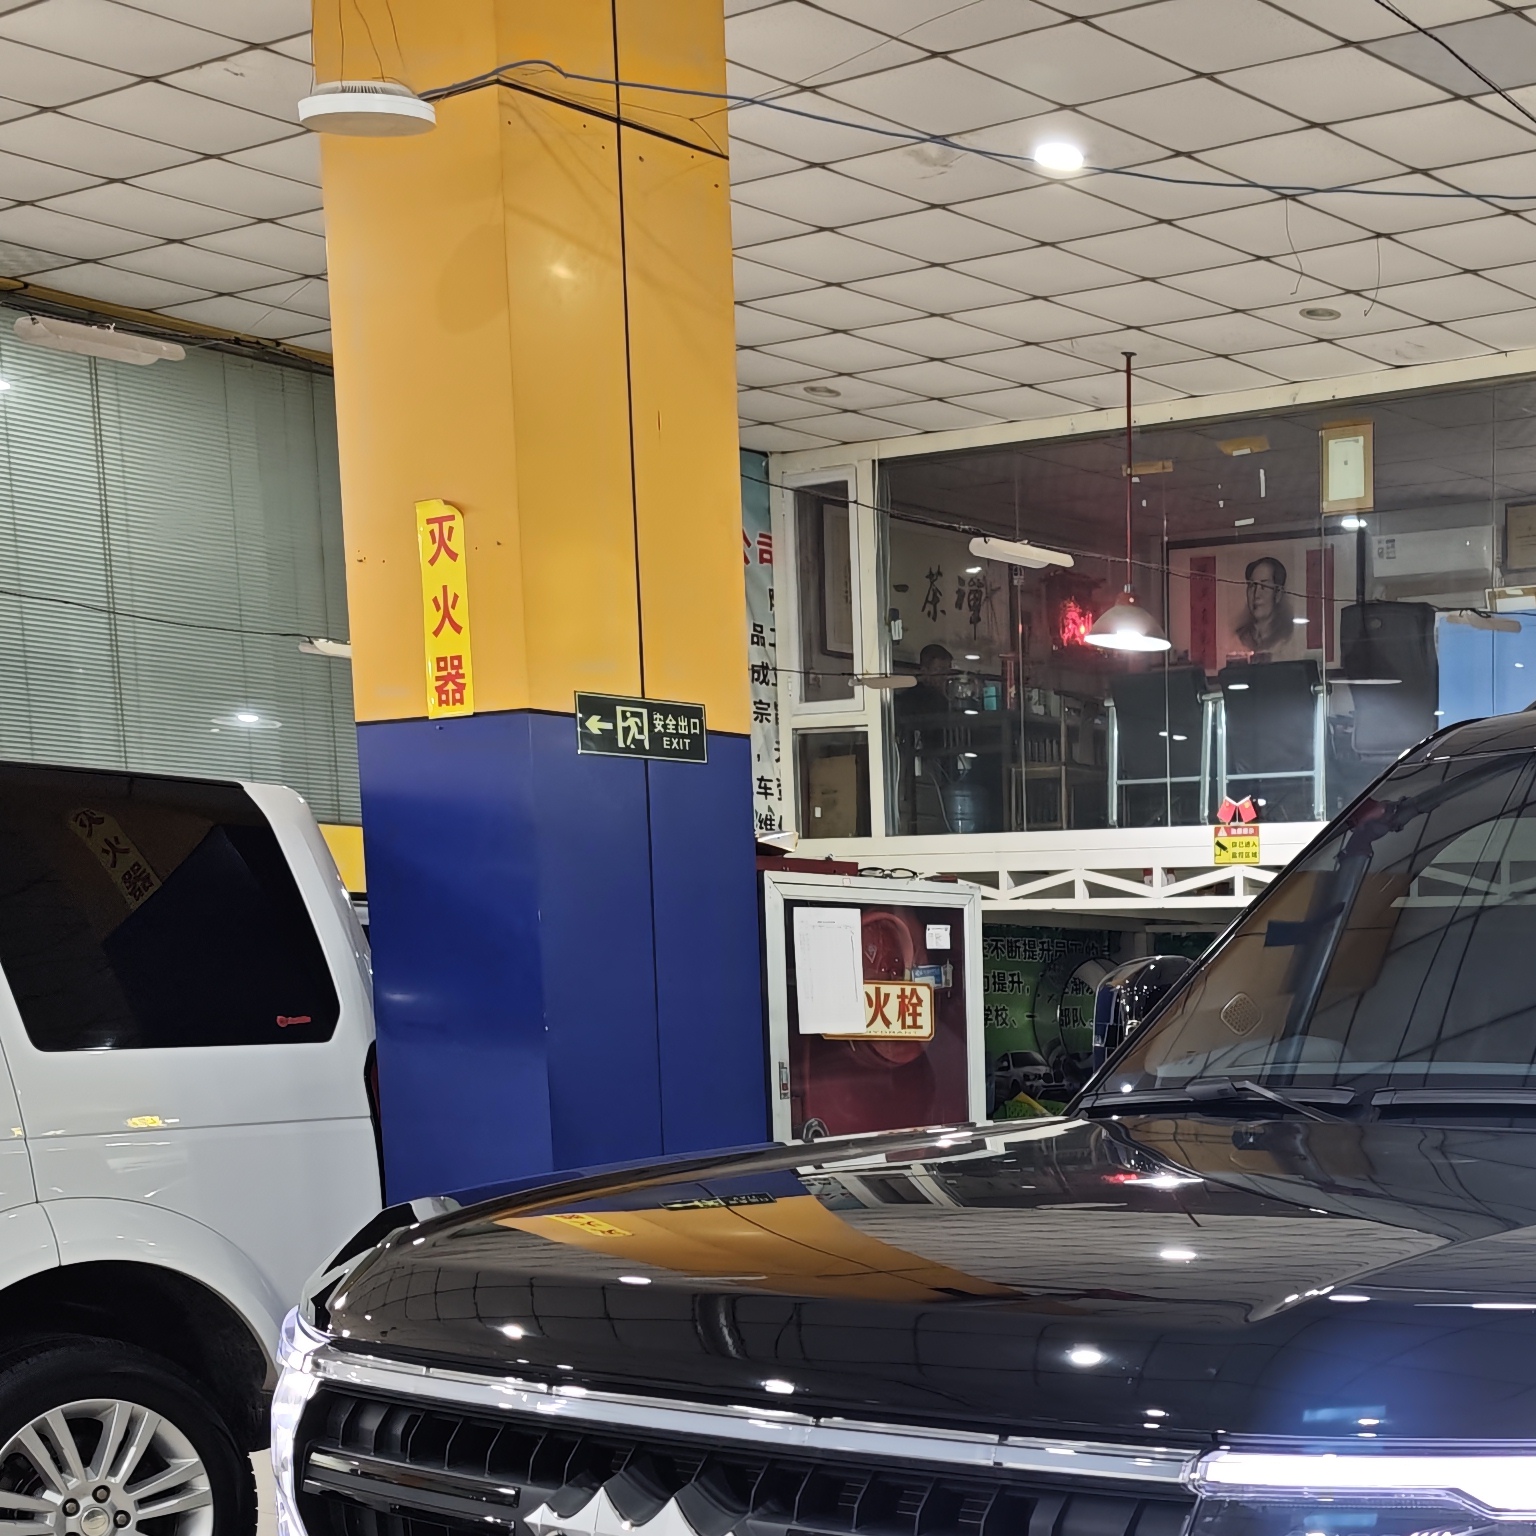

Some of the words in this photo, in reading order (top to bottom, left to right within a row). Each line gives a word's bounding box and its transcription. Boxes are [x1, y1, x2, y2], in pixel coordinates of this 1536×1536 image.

[425, 514, 467, 708] 灭火器
[652, 712, 700, 735] 安全出口
[663, 736, 691, 750] EXIT
